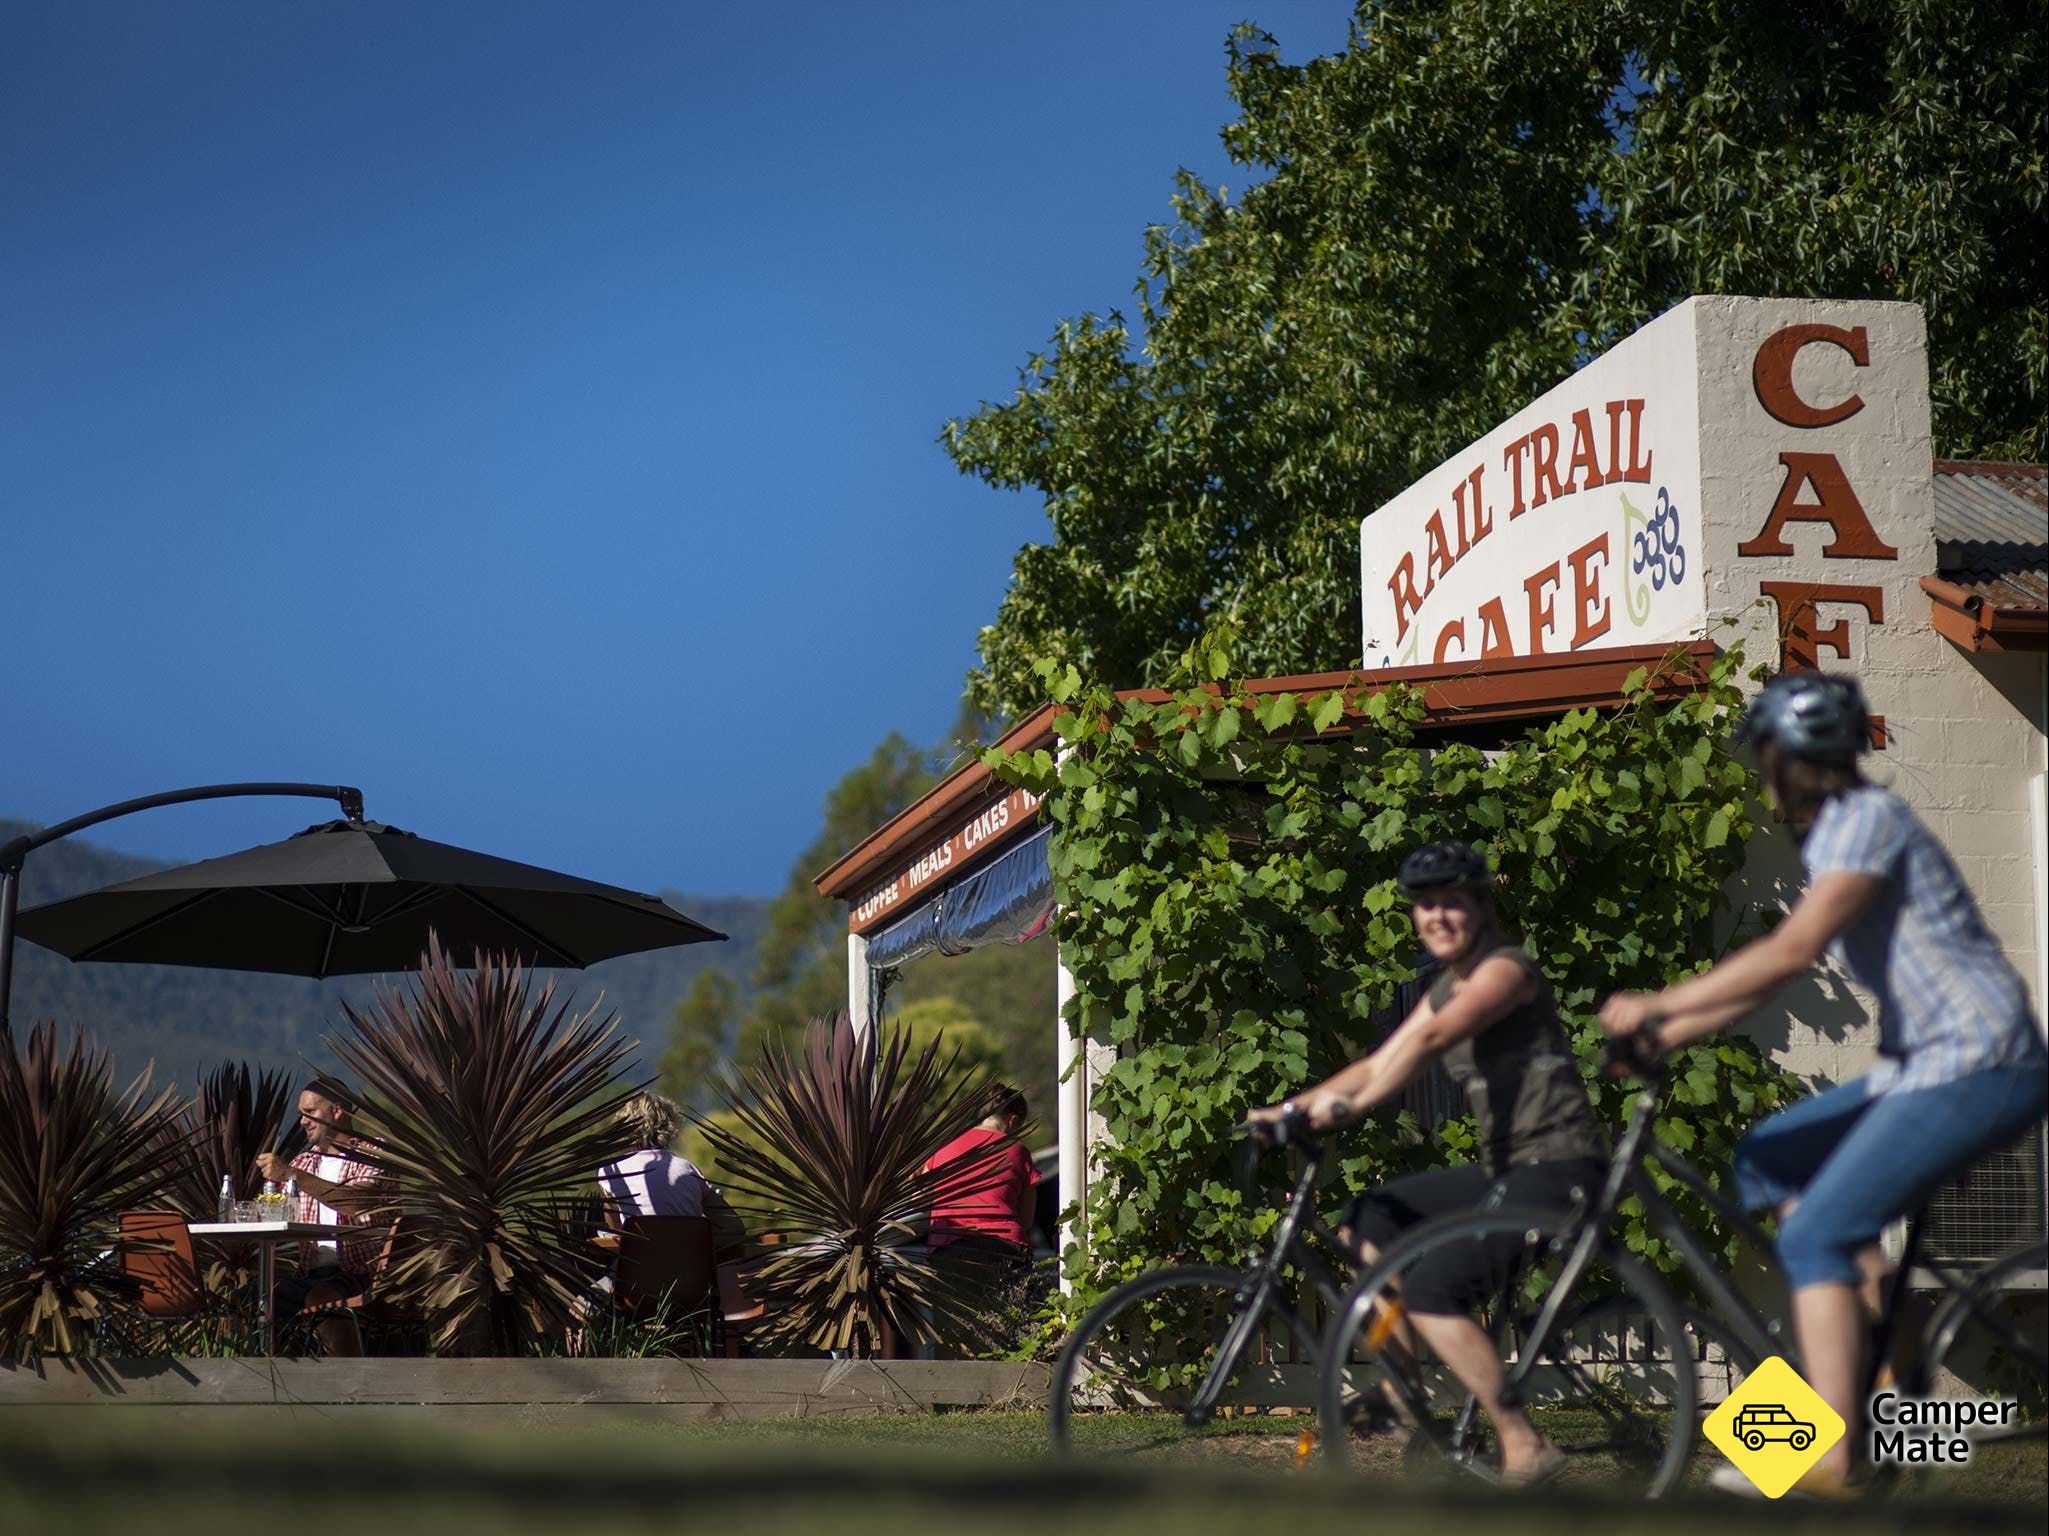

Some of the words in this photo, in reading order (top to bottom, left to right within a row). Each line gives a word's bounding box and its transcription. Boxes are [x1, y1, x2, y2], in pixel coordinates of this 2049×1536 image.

[1387, 463, 1493, 646] RAIL
[1503, 398, 1652, 521] TRAIL
[1737, 323, 1898, 823] CAF
[908, 837, 953, 889] MEALS
[963, 798, 1009, 850] CAKES
